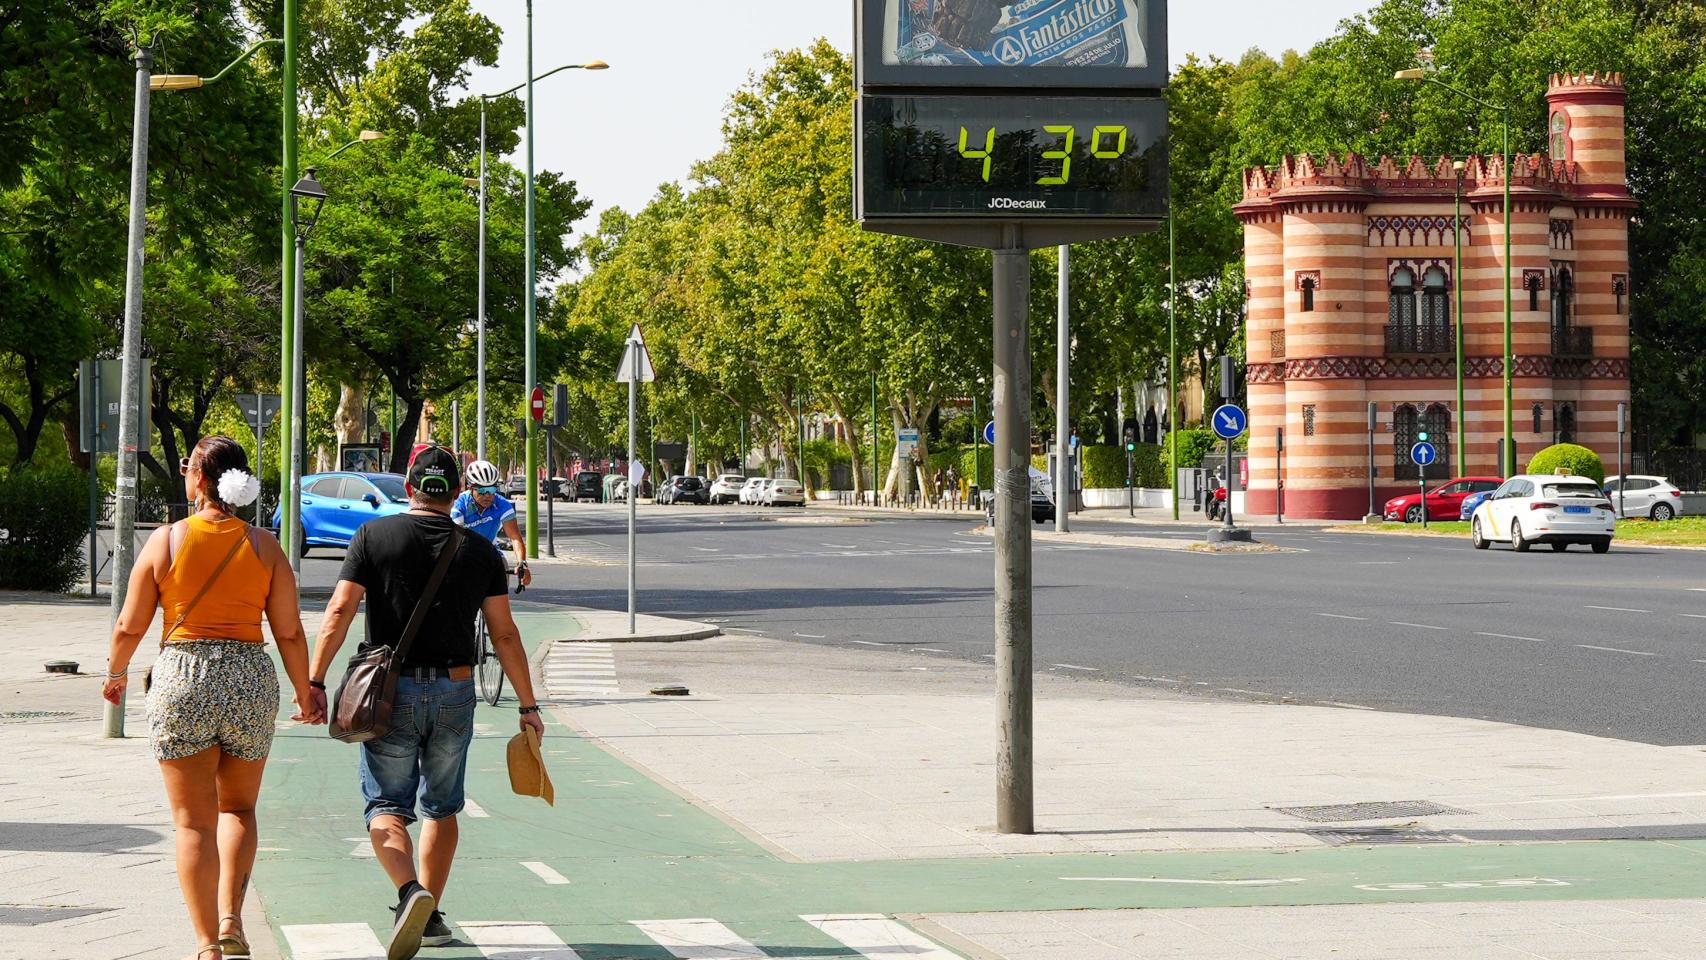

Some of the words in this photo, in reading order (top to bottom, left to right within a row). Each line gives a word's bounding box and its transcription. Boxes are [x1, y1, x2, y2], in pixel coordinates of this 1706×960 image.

[999, 39, 1022, 63] 4
[1019, 0, 1117, 57] Fantásticos
[1037, 32, 1085, 59] PRIMEROS
[1084, 51, 1095, 59] 24
[1093, 46, 1104, 54] DE
[1102, 38, 1121, 51] JULIO
[988, 197, 1046, 209] JCDecaux
